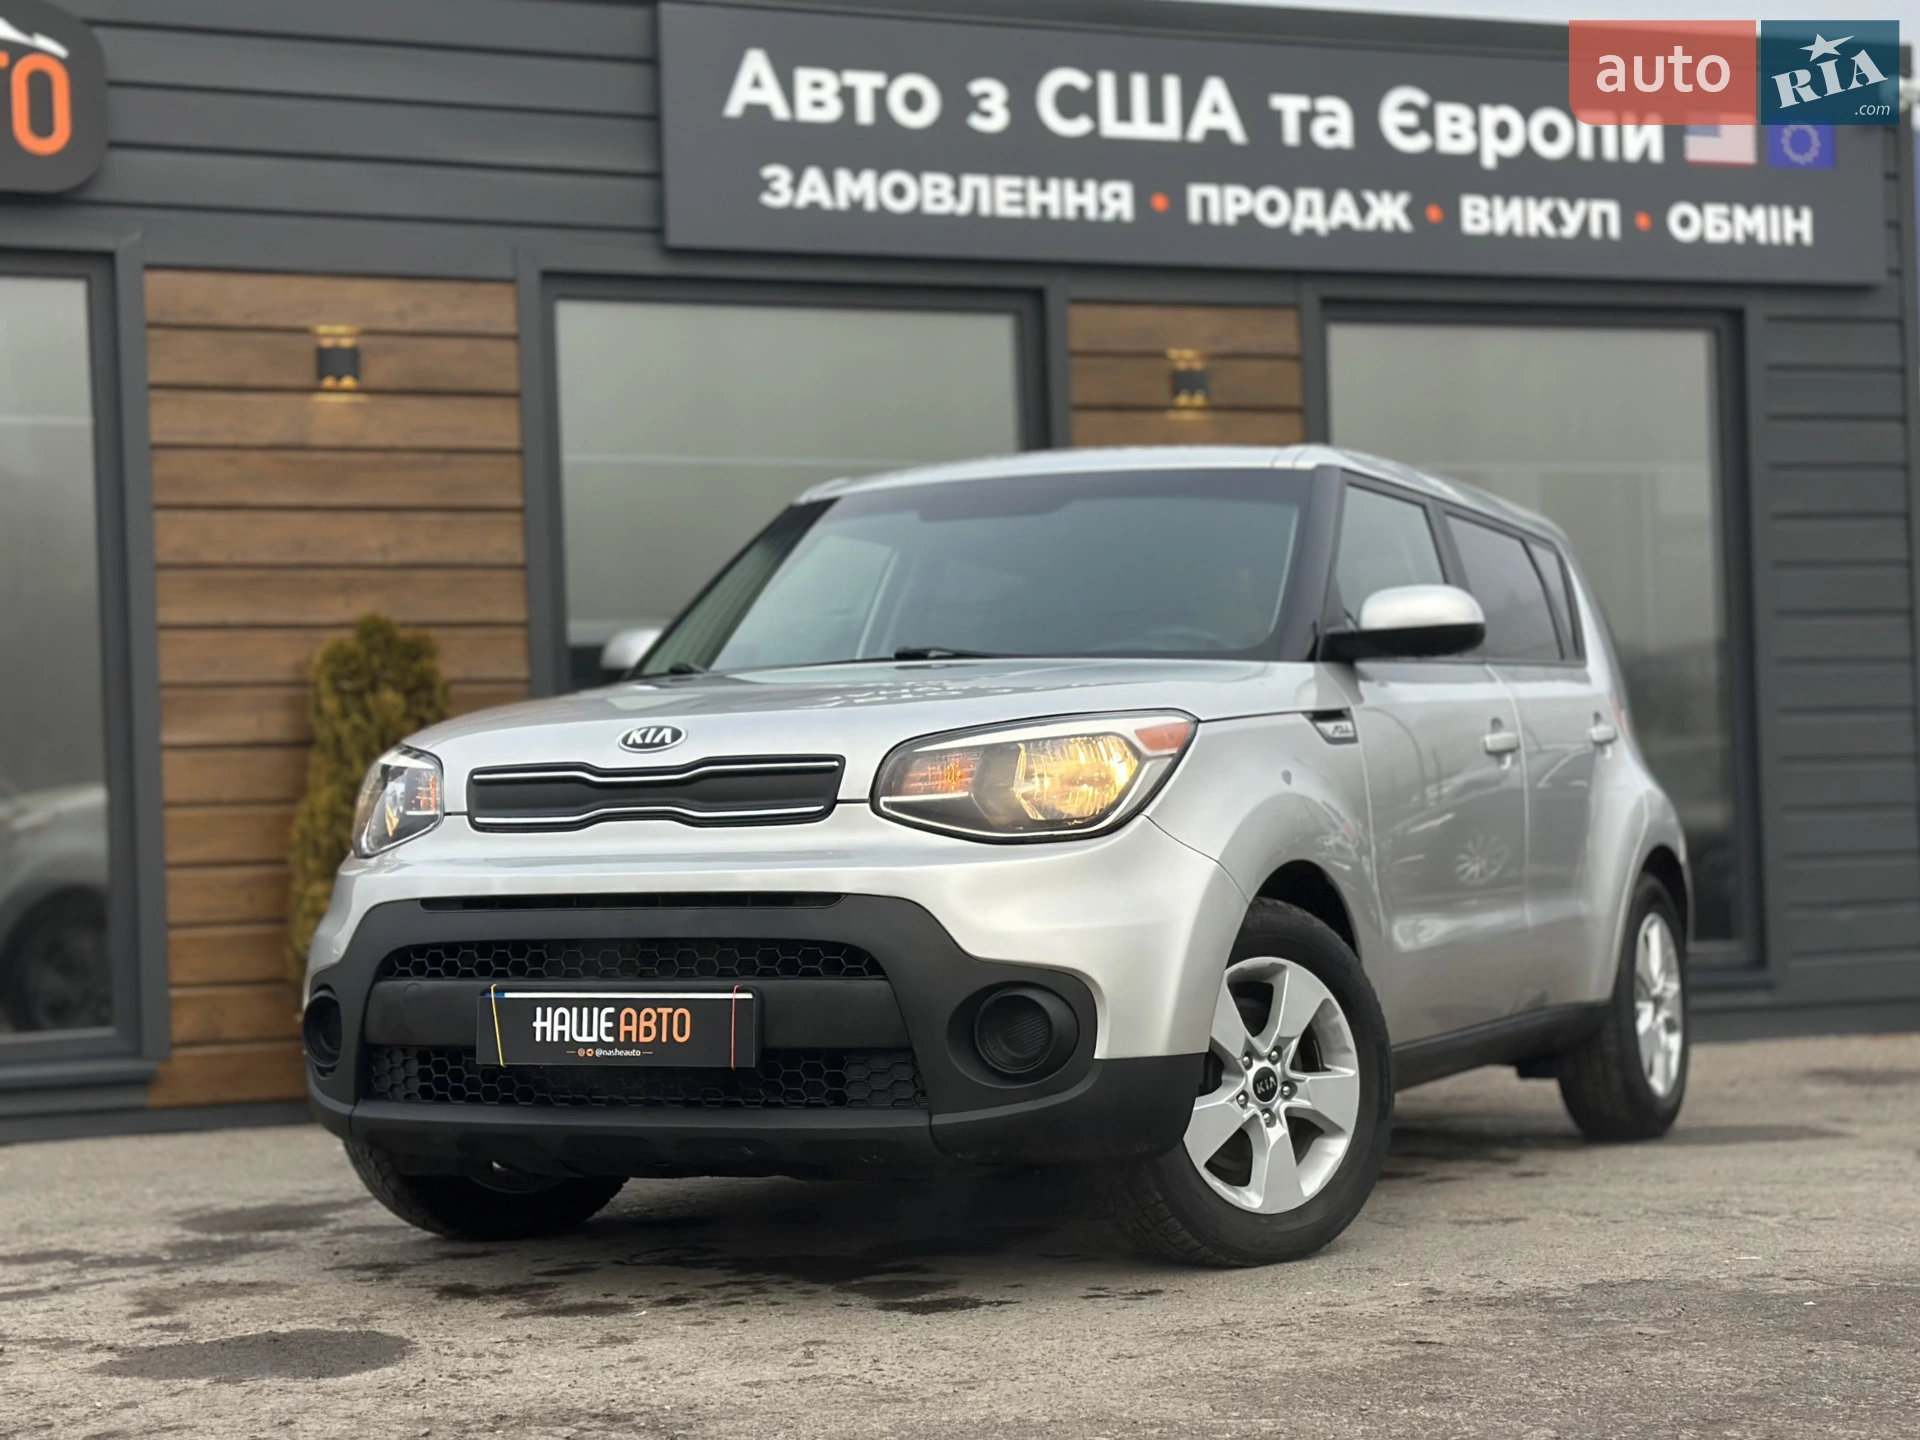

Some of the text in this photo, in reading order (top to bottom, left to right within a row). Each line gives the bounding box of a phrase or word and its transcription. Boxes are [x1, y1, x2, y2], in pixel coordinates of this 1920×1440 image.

[723, 47, 943, 130] Авто
[1035, 66, 1249, 145] США
[1269, 92, 1355, 151] та
[1378, 84, 1664, 170] Європи
[759, 164, 1814, 246] ЗАМОВЛЕННЯ ПРОДАЖ ВИКУП ОБМІН
[626, 727, 673, 745] KIA
[532, 1007, 691, 1043] НАШЕ АВТО
[595, 1048, 641, 1057] @nasheauto
[1256, 1076, 1277, 1094] KIA
